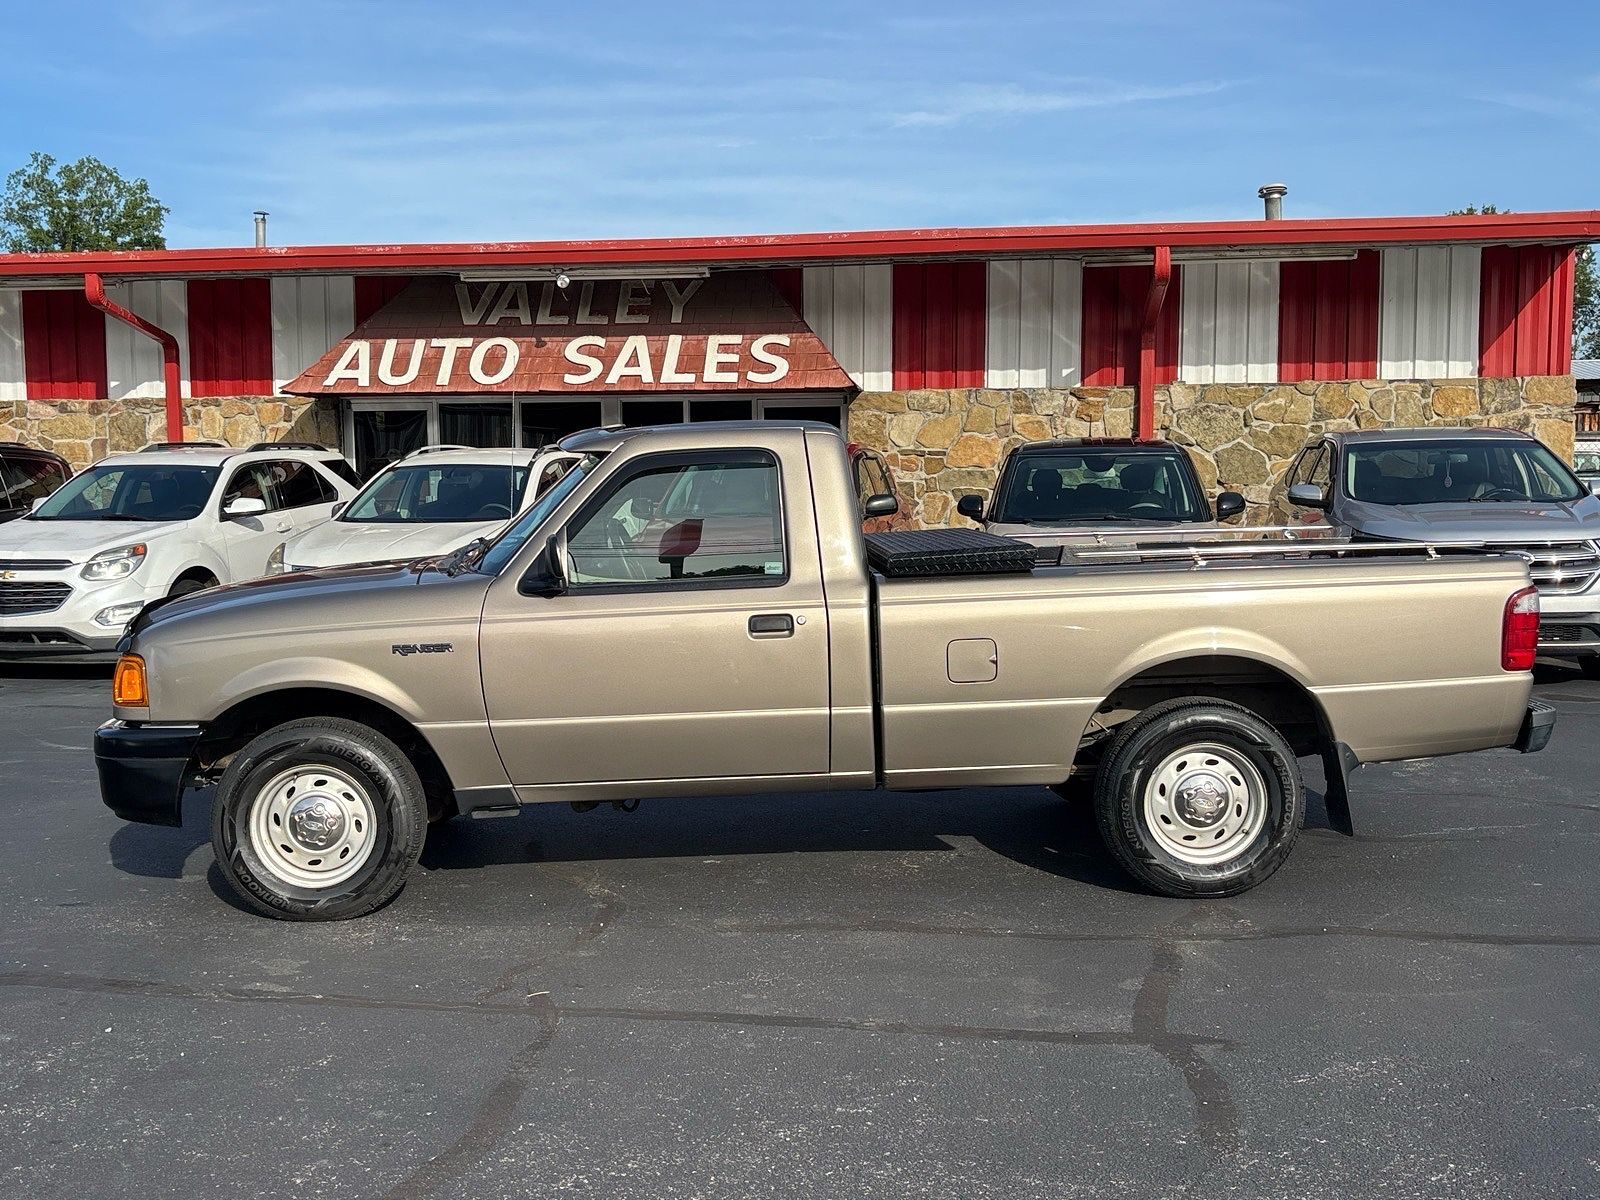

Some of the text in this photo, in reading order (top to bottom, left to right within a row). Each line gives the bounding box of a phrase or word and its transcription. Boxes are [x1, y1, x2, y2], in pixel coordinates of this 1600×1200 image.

[454, 279, 704, 325] VALLEY
[322, 334, 791, 387] AUTO SALES
[392, 643, 454, 656] RANGER
